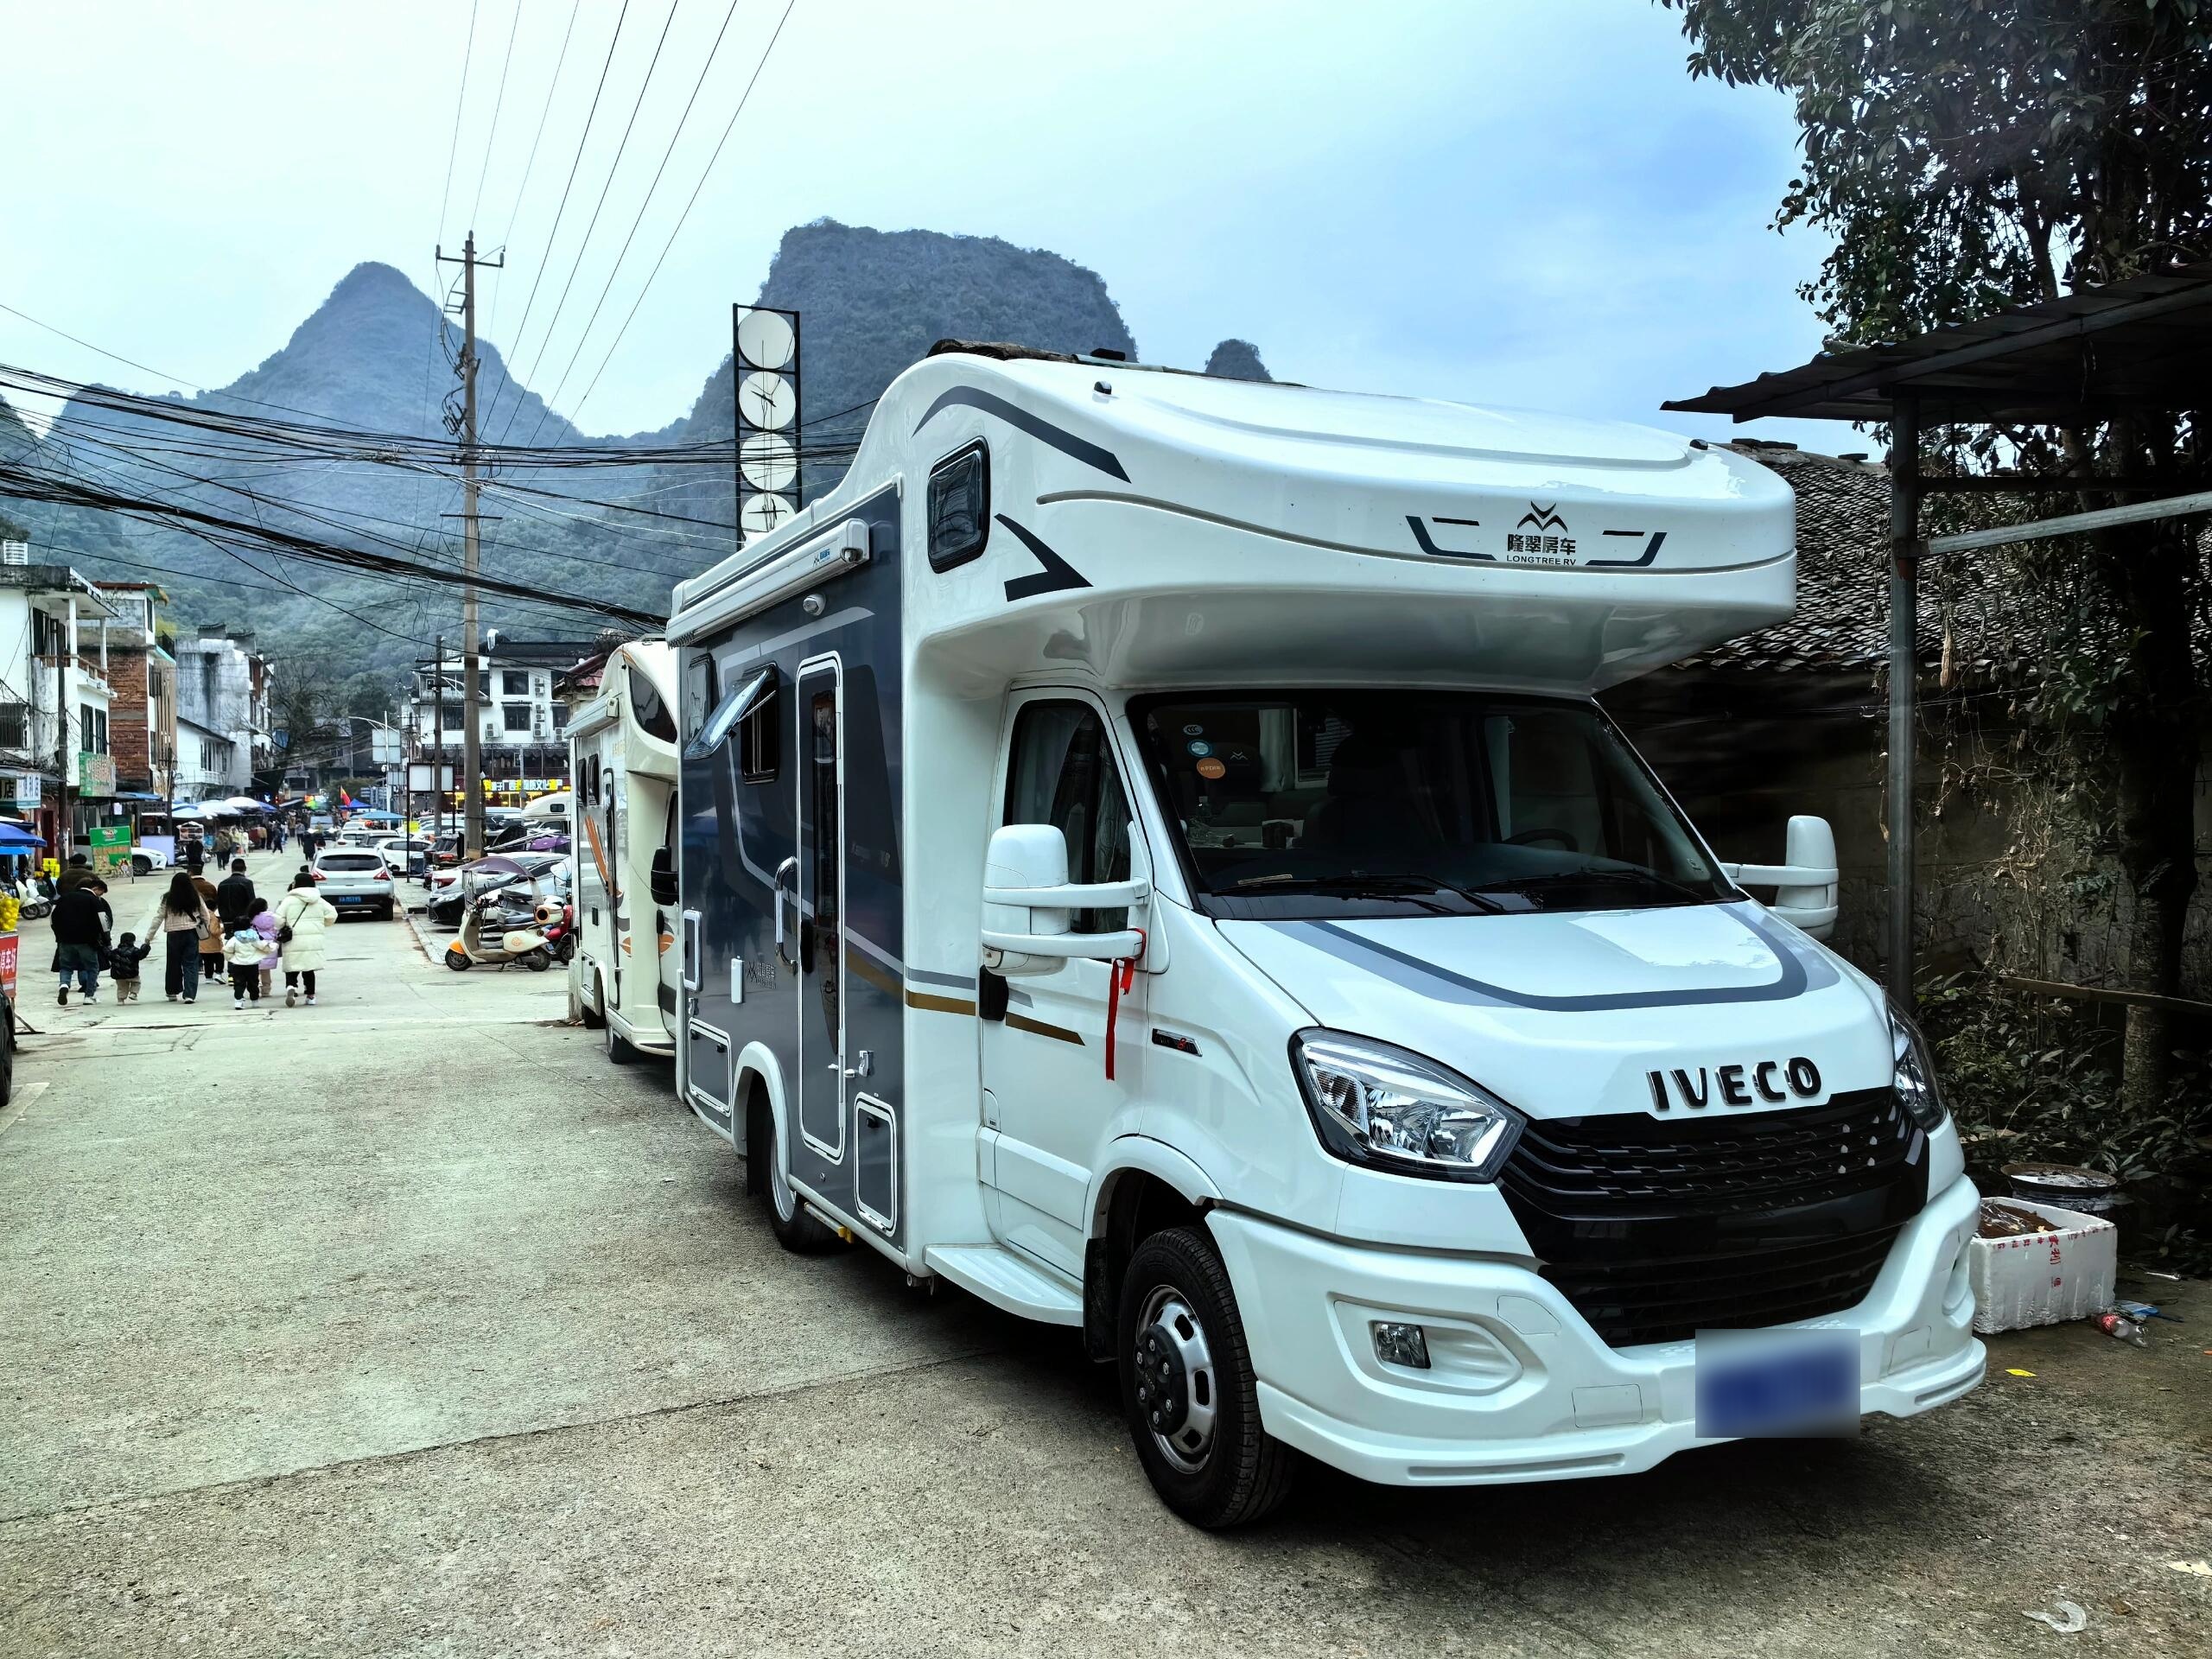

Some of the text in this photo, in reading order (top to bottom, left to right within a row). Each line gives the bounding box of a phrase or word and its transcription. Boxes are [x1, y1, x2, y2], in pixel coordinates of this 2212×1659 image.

[1507, 533, 1576, 556] 隆翠房车
[1506, 555, 1560, 565] LONGTREE
[1645, 1056, 1822, 1112] IVECO
